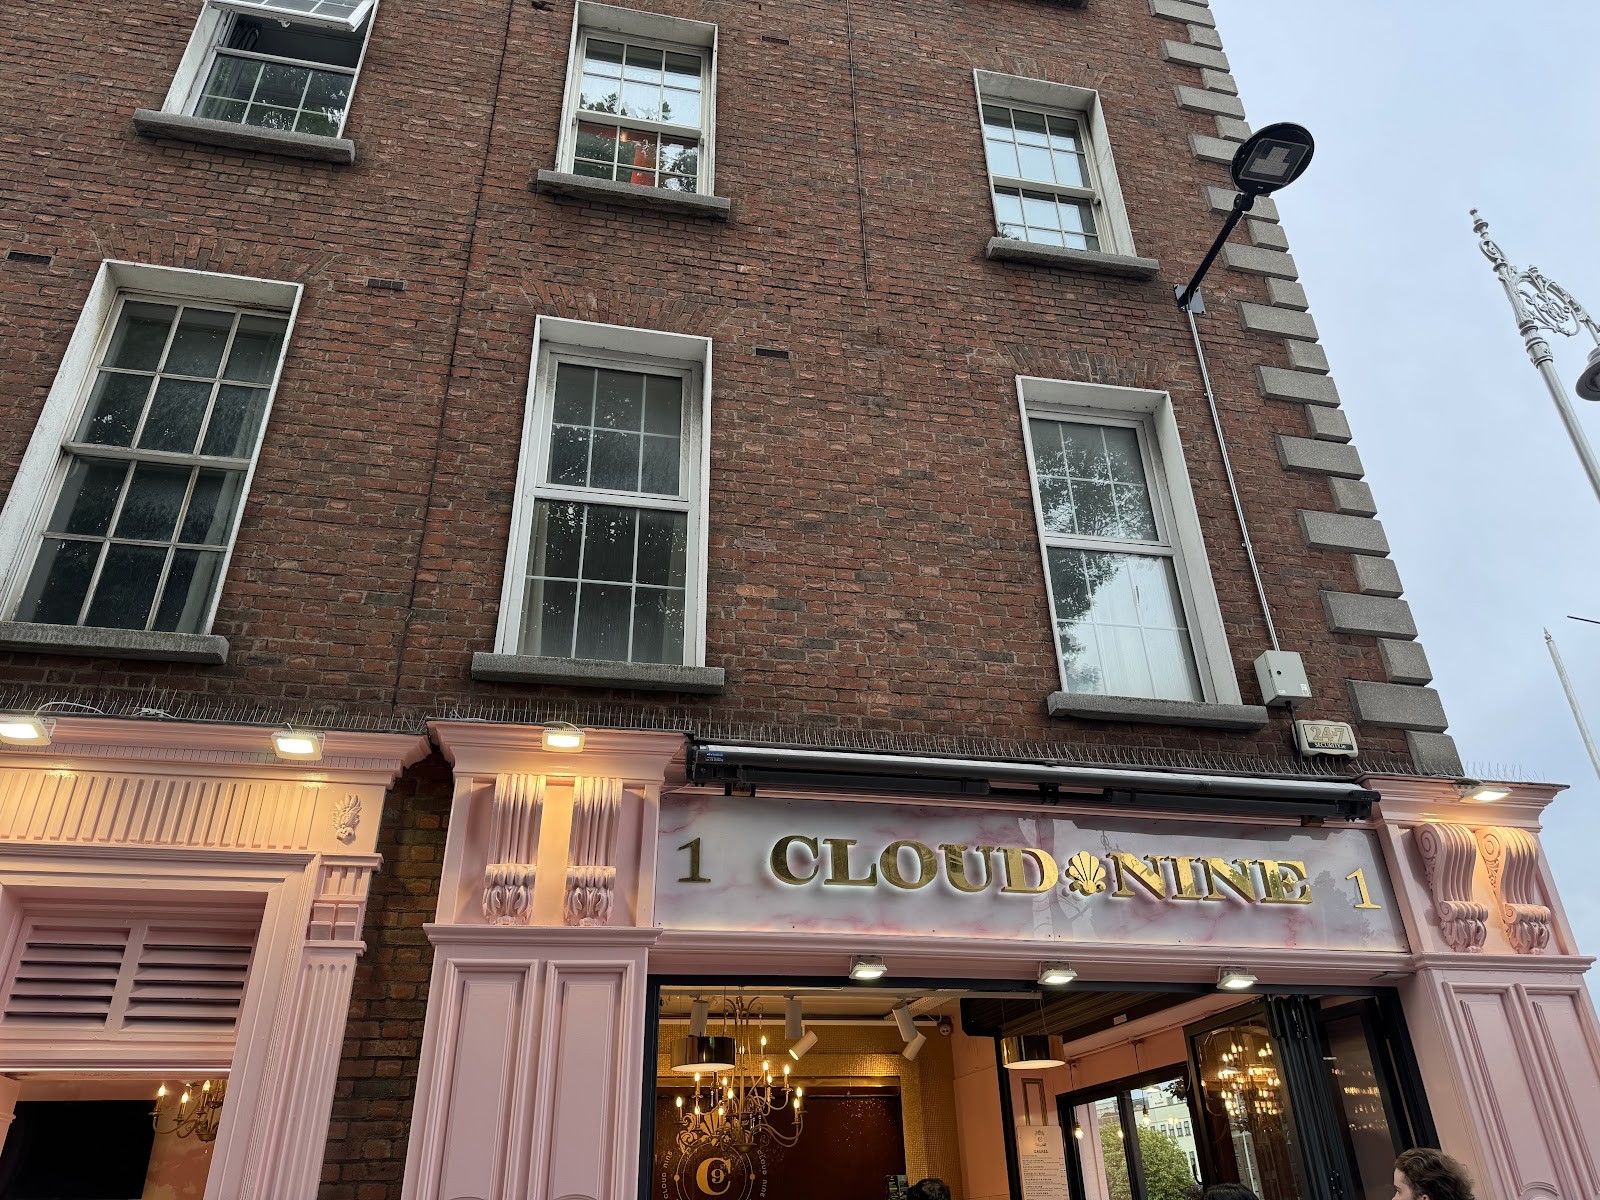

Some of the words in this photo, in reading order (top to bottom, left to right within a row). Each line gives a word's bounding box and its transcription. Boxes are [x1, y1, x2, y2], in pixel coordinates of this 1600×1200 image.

[677, 837, 711, 883] 1
[769, 835, 1059, 893] CLOUD
[1106, 851, 1313, 904] NINE
[1346, 867, 1381, 909] 1
[661, 1172, 669, 1199] CLOUD
[696, 1157, 731, 1195] C
[711, 1168, 724, 1184] 9
